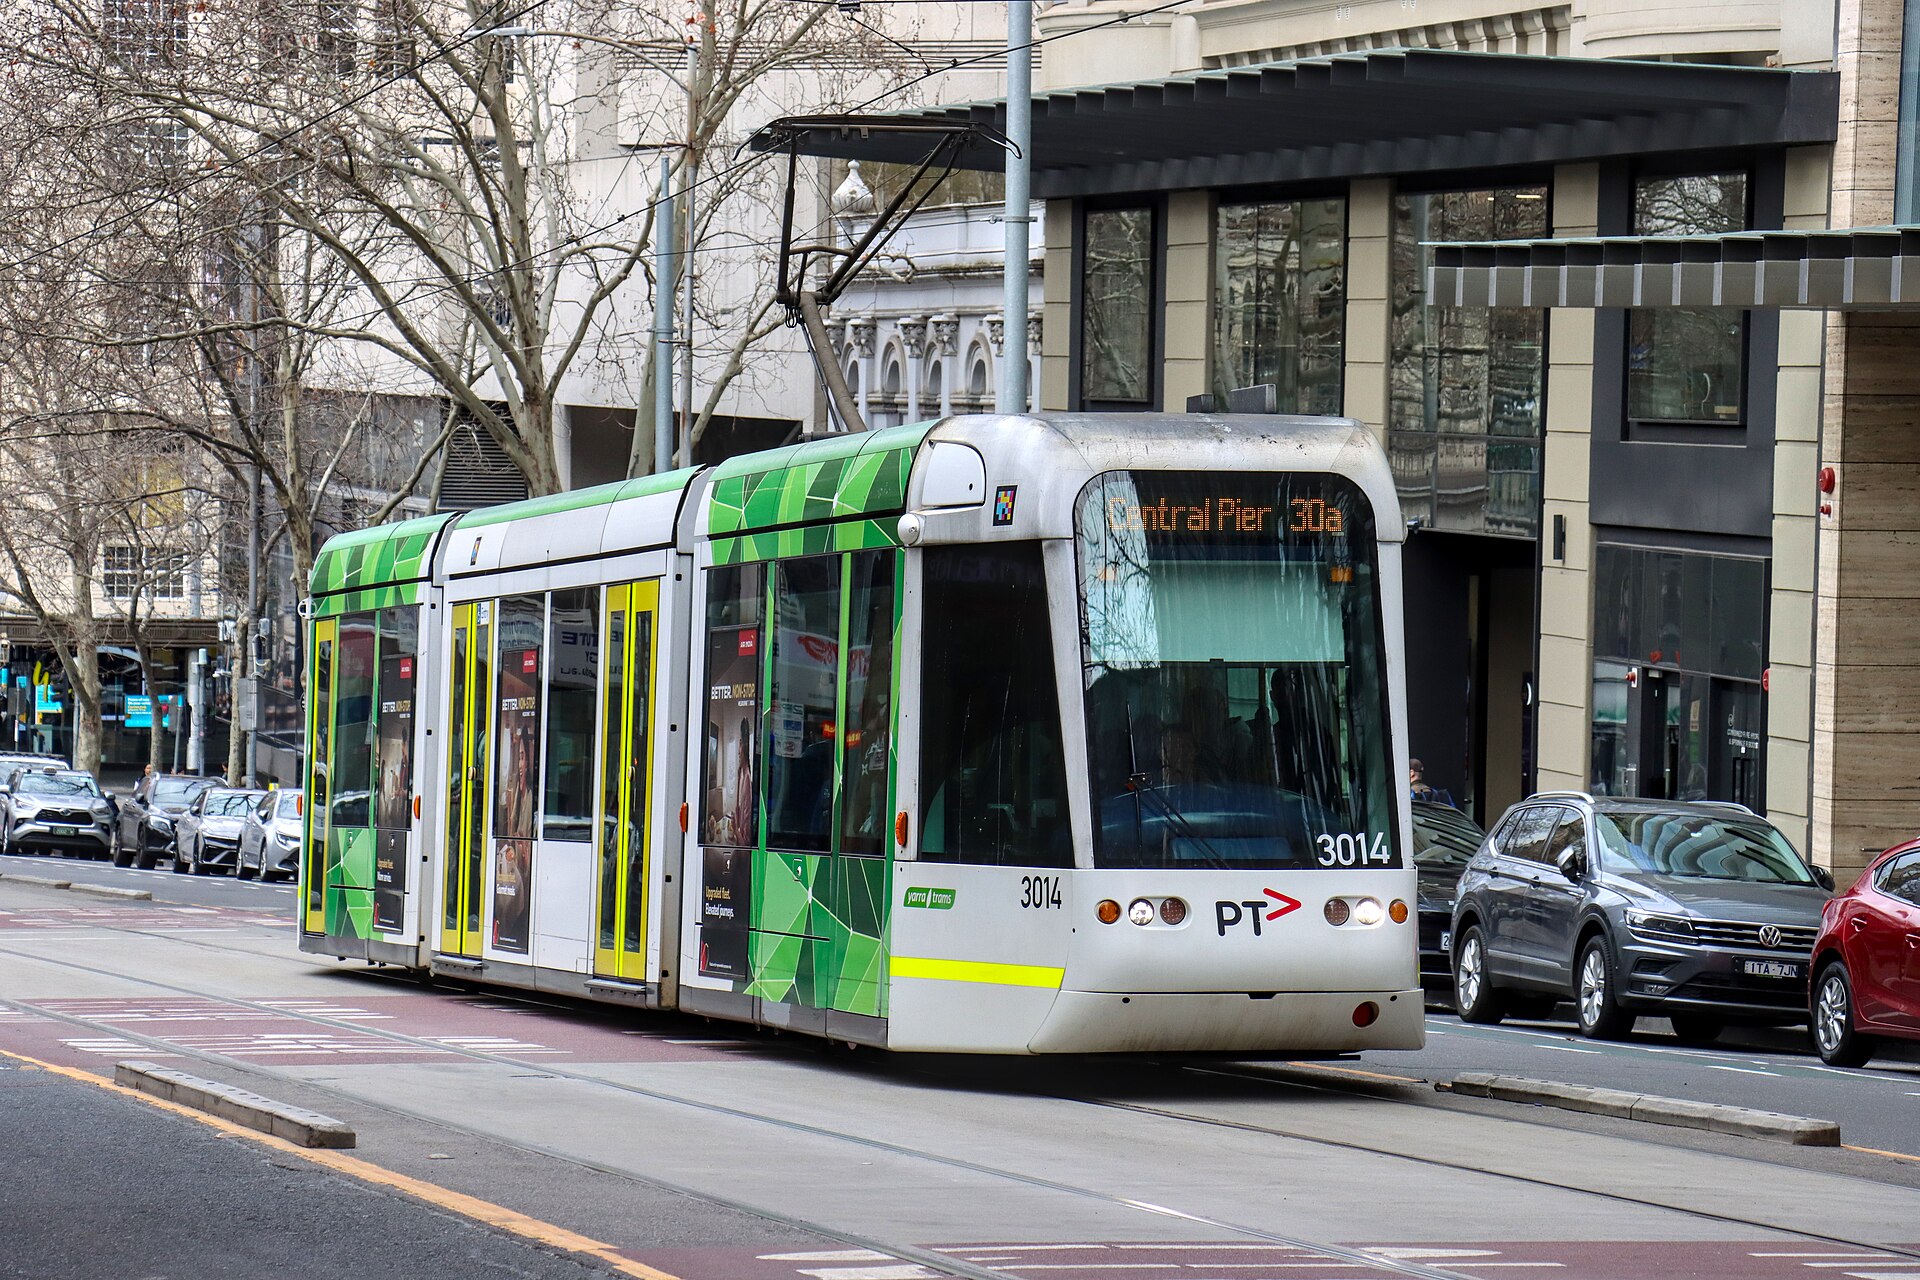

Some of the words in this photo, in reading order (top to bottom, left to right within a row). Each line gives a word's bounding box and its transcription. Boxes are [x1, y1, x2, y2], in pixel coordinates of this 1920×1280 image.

[1109, 498, 1210, 531] Central
[1218, 498, 1272, 531] Pier
[1290, 498, 1343, 532] 30a
[1316, 832, 1390, 867] 3014
[705, 885, 721, 900] Upgraded
[908, 891, 926, 904] yarra
[932, 891, 951, 904] trams
[1021, 876, 1062, 909] 3014
